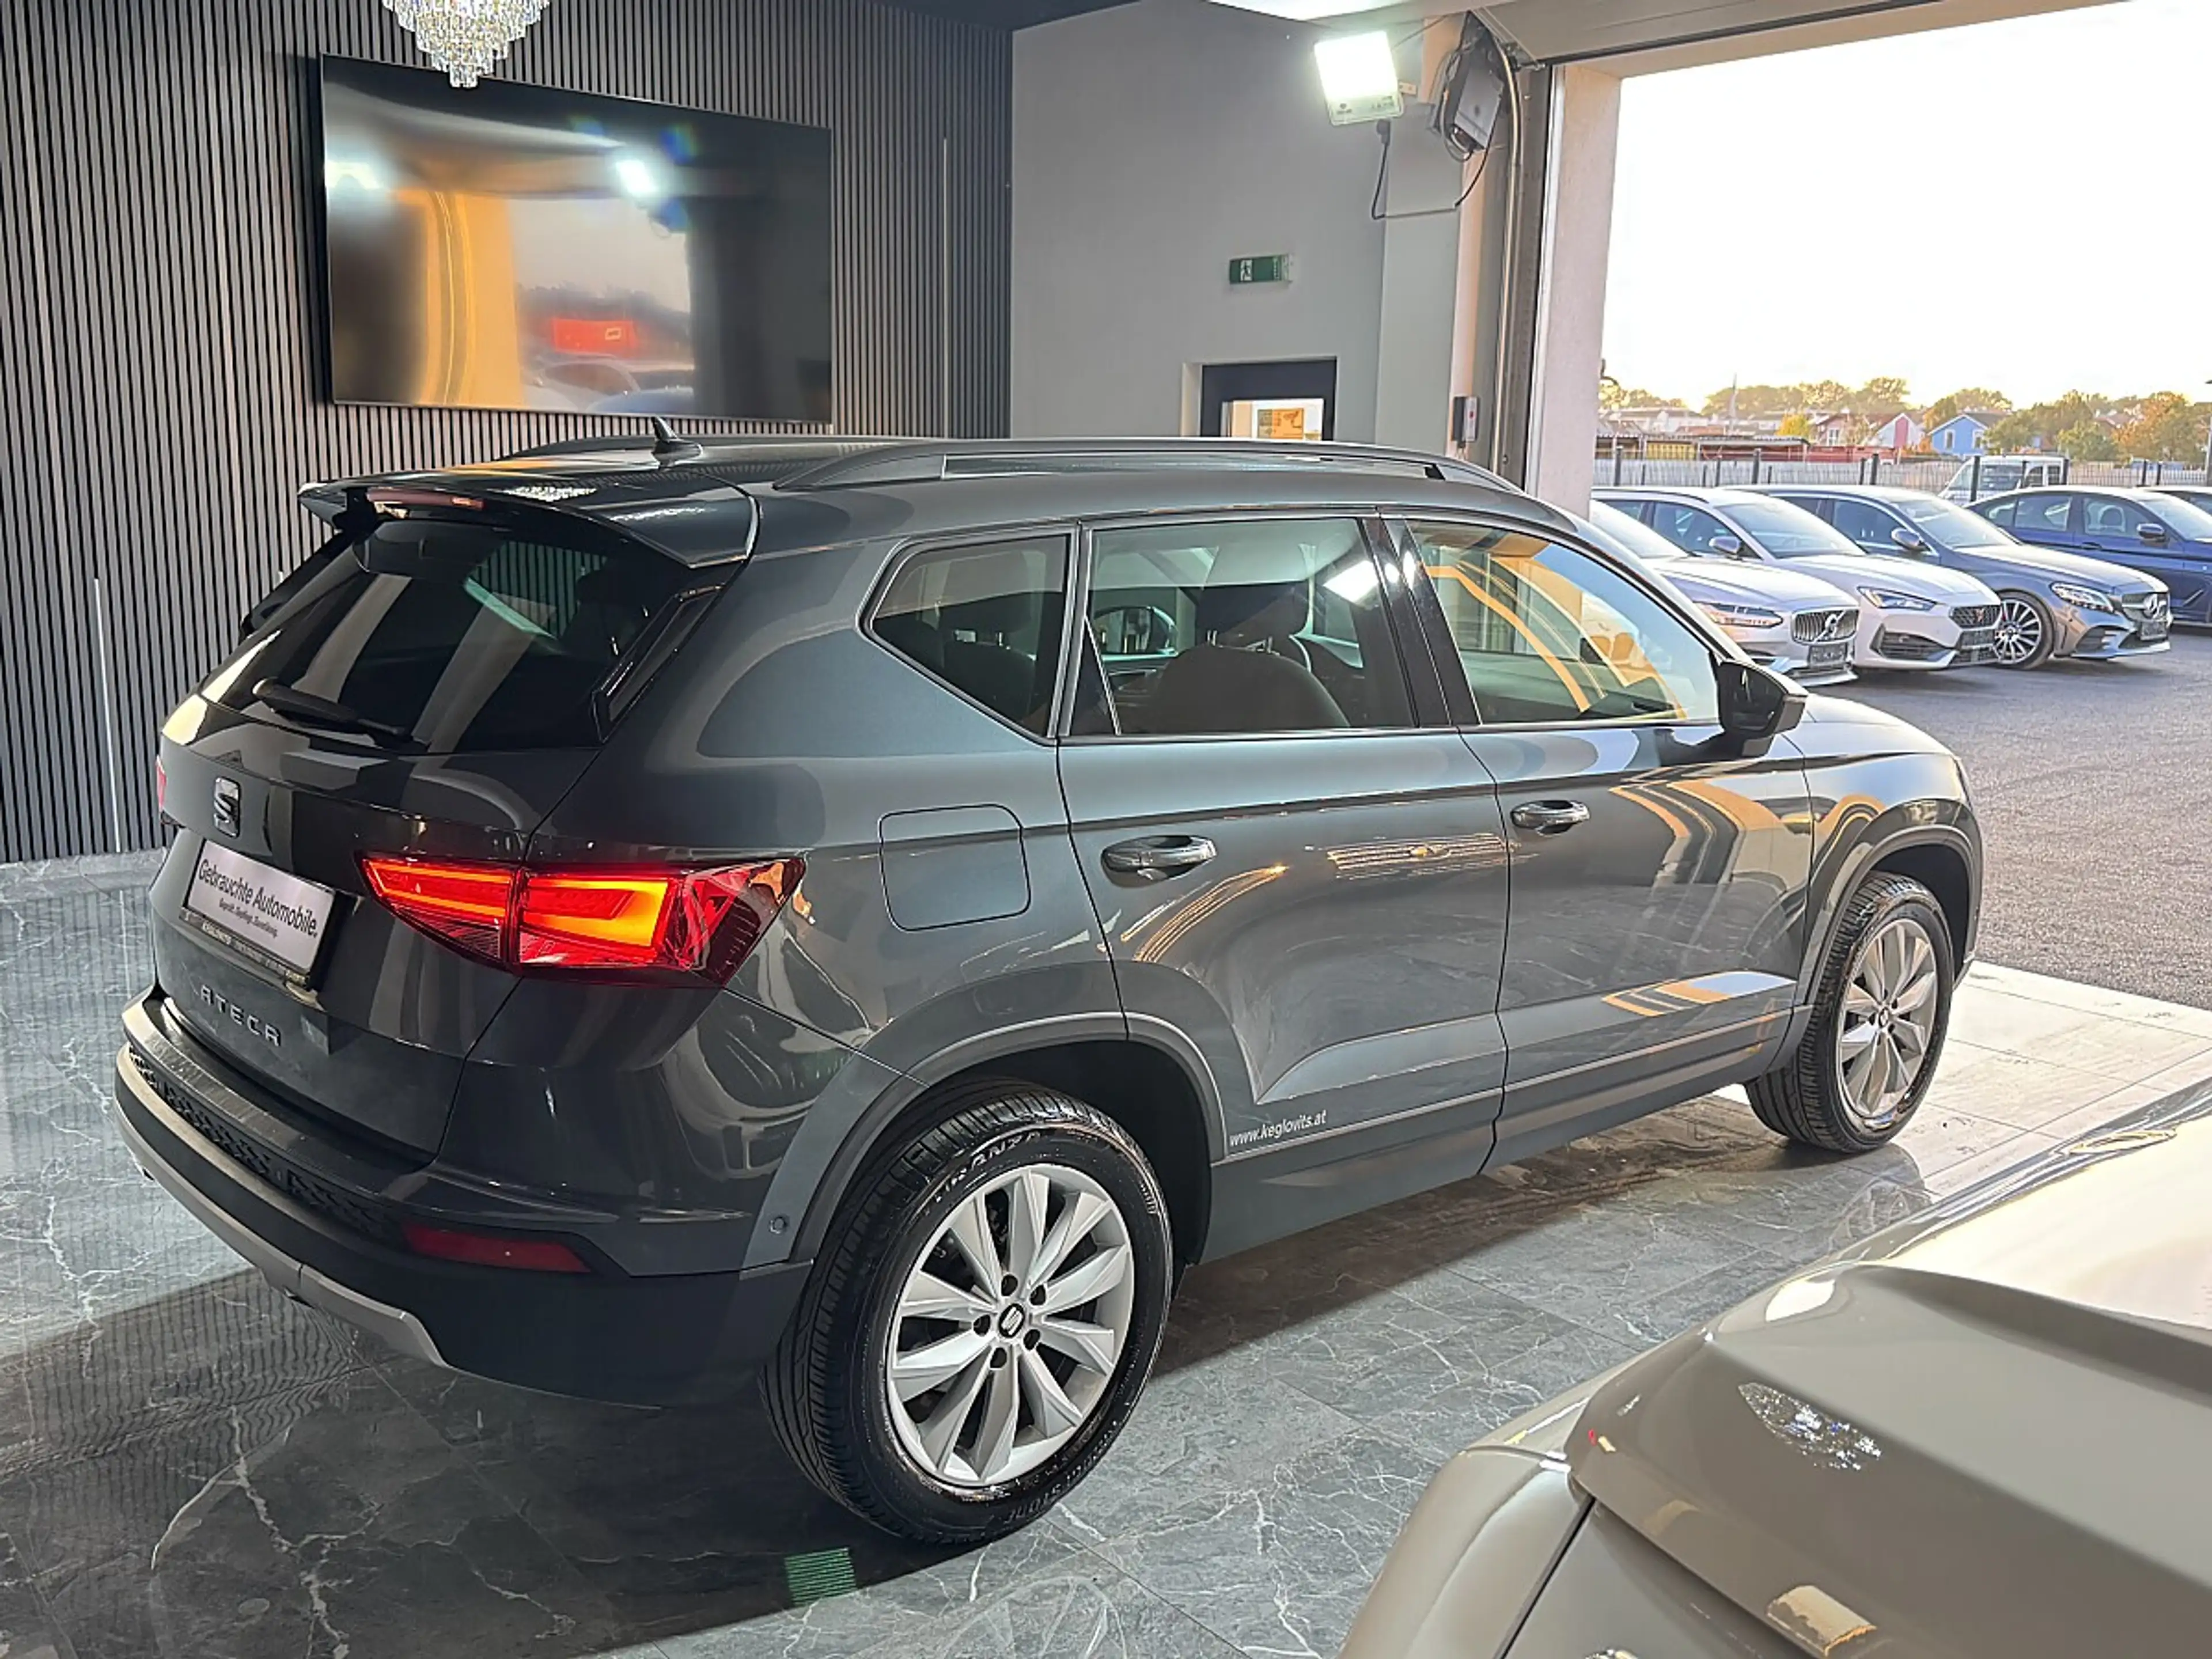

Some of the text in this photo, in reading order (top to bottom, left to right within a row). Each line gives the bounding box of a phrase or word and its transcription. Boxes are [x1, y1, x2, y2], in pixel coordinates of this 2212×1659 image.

[199, 859, 253, 904] Gebrauchte
[252, 886, 319, 938] Automobile.
[200, 984, 281, 1046] ATECA
[1229, 1109, 1327, 1146] www.keglovits.at
